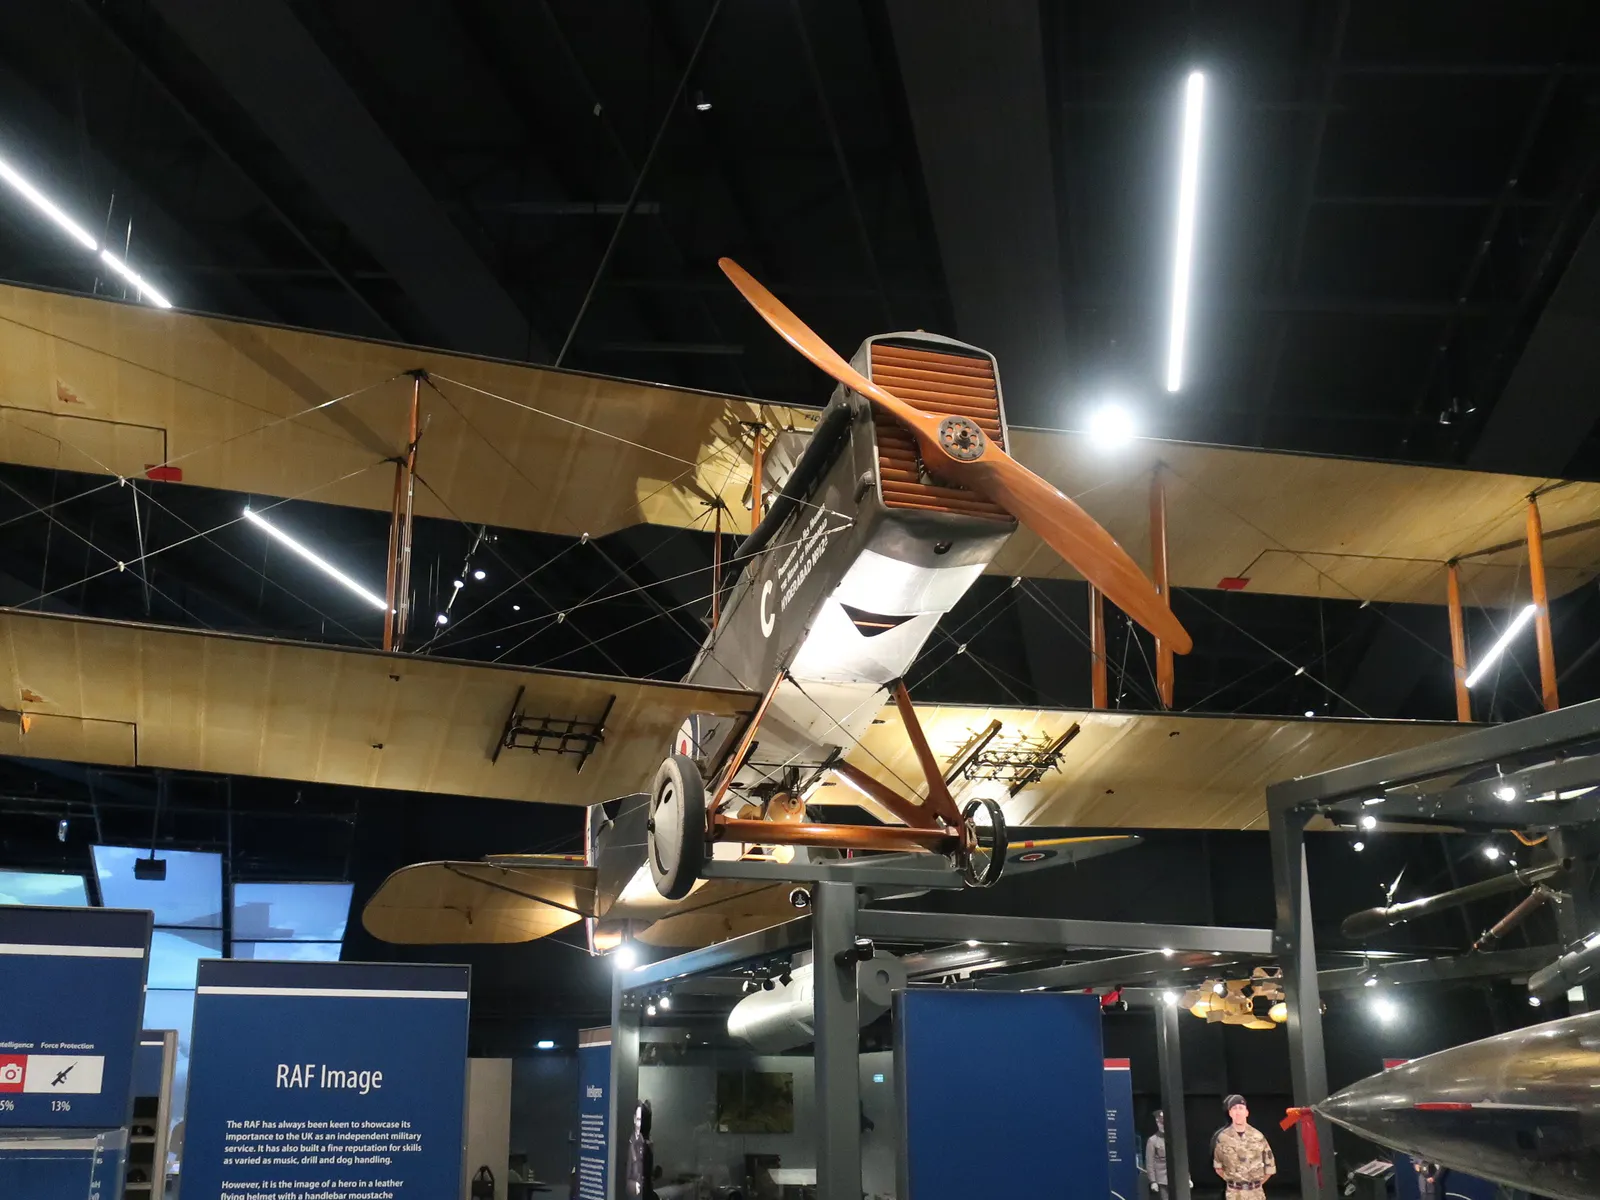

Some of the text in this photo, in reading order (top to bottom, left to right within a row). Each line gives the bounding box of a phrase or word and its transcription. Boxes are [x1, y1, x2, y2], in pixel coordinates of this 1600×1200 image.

[781, 559, 812, 612] HYDERABAD
[760, 579, 775, 638] C
[0, 1041, 34, 1050] ntelligence
[61, 1042, 94, 1050] Protection
[276, 1063, 383, 1095] RAF Image
[51, 1100, 71, 1112] 13%
[227, 1120, 411, 1131] The RAF has always been keen to showcase its
[225, 1132, 274, 1142] importance
[275, 1132, 284, 1141] to
[286, 1132, 300, 1141] the
[301, 1132, 313, 1141] UK
[337, 1132, 389, 1142] independent
[390, 1132, 422, 1142] military
[224, 1144, 256, 1152] service.
[258, 1144, 264, 1152] It
[266, 1144, 280, 1152] has
[282, 1144, 298, 1152] also
[300, 1144, 319, 1152] built
[327, 1144, 344, 1152] fine
[345, 1144, 388, 1153] reputation
[389, 1144, 401, 1152] for
[402, 1144, 422, 1152] skills
[234, 1156, 261, 1164] varied
[273, 1156, 299, 1165] music,
[301, 1156, 317, 1164] drill
[319, 1156, 335, 1164] and
[336, 1156, 353, 1165] dog
[354, 1156, 393, 1165] handling.
[221, 1180, 260, 1189] However,
[262, 1180, 269, 1188] it
[270, 1180, 277, 1188] is
[278, 1180, 293, 1188] the
[294, 1180, 320, 1189] image
[321, 1180, 331, 1188] of
[338, 1179, 357, 1187] hero
[359, 1179, 367, 1187] in
[375, 1179, 404, 1187] leather
[220, 1192, 245, 1200] flying
[247, 1192, 276, 1200] helmet
[278, 1192, 297, 1200] with
[305, 1192, 347, 1200] handlebar
[348, 1192, 393, 1200] moustache
